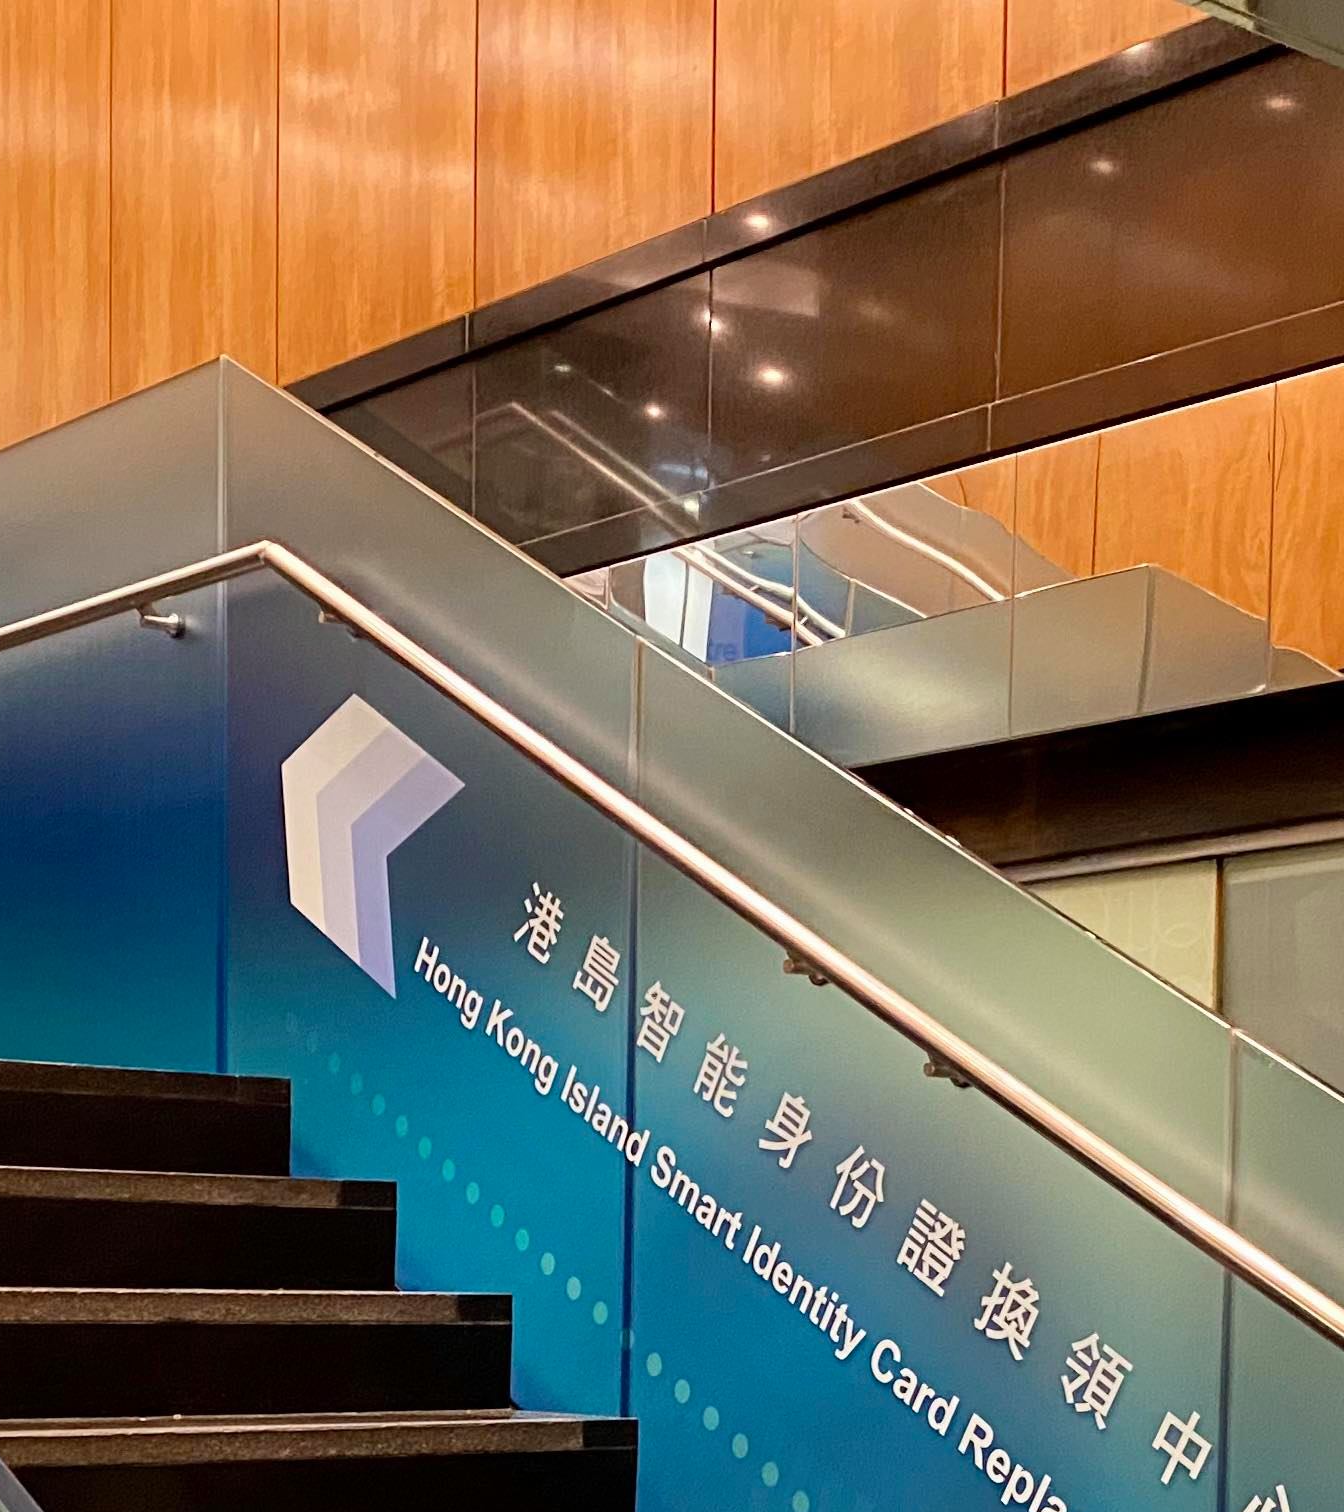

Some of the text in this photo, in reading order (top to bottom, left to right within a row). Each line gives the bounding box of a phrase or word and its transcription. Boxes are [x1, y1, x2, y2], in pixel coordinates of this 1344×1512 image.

[413, 937, 484, 1029] Hong
[485, 999, 559, 1096] Kong
[561, 1065, 651, 1168] Island
[650, 1145, 744, 1251] Smart
[742, 1225, 867, 1361] Identity
[870, 1338, 960, 1437] Card
